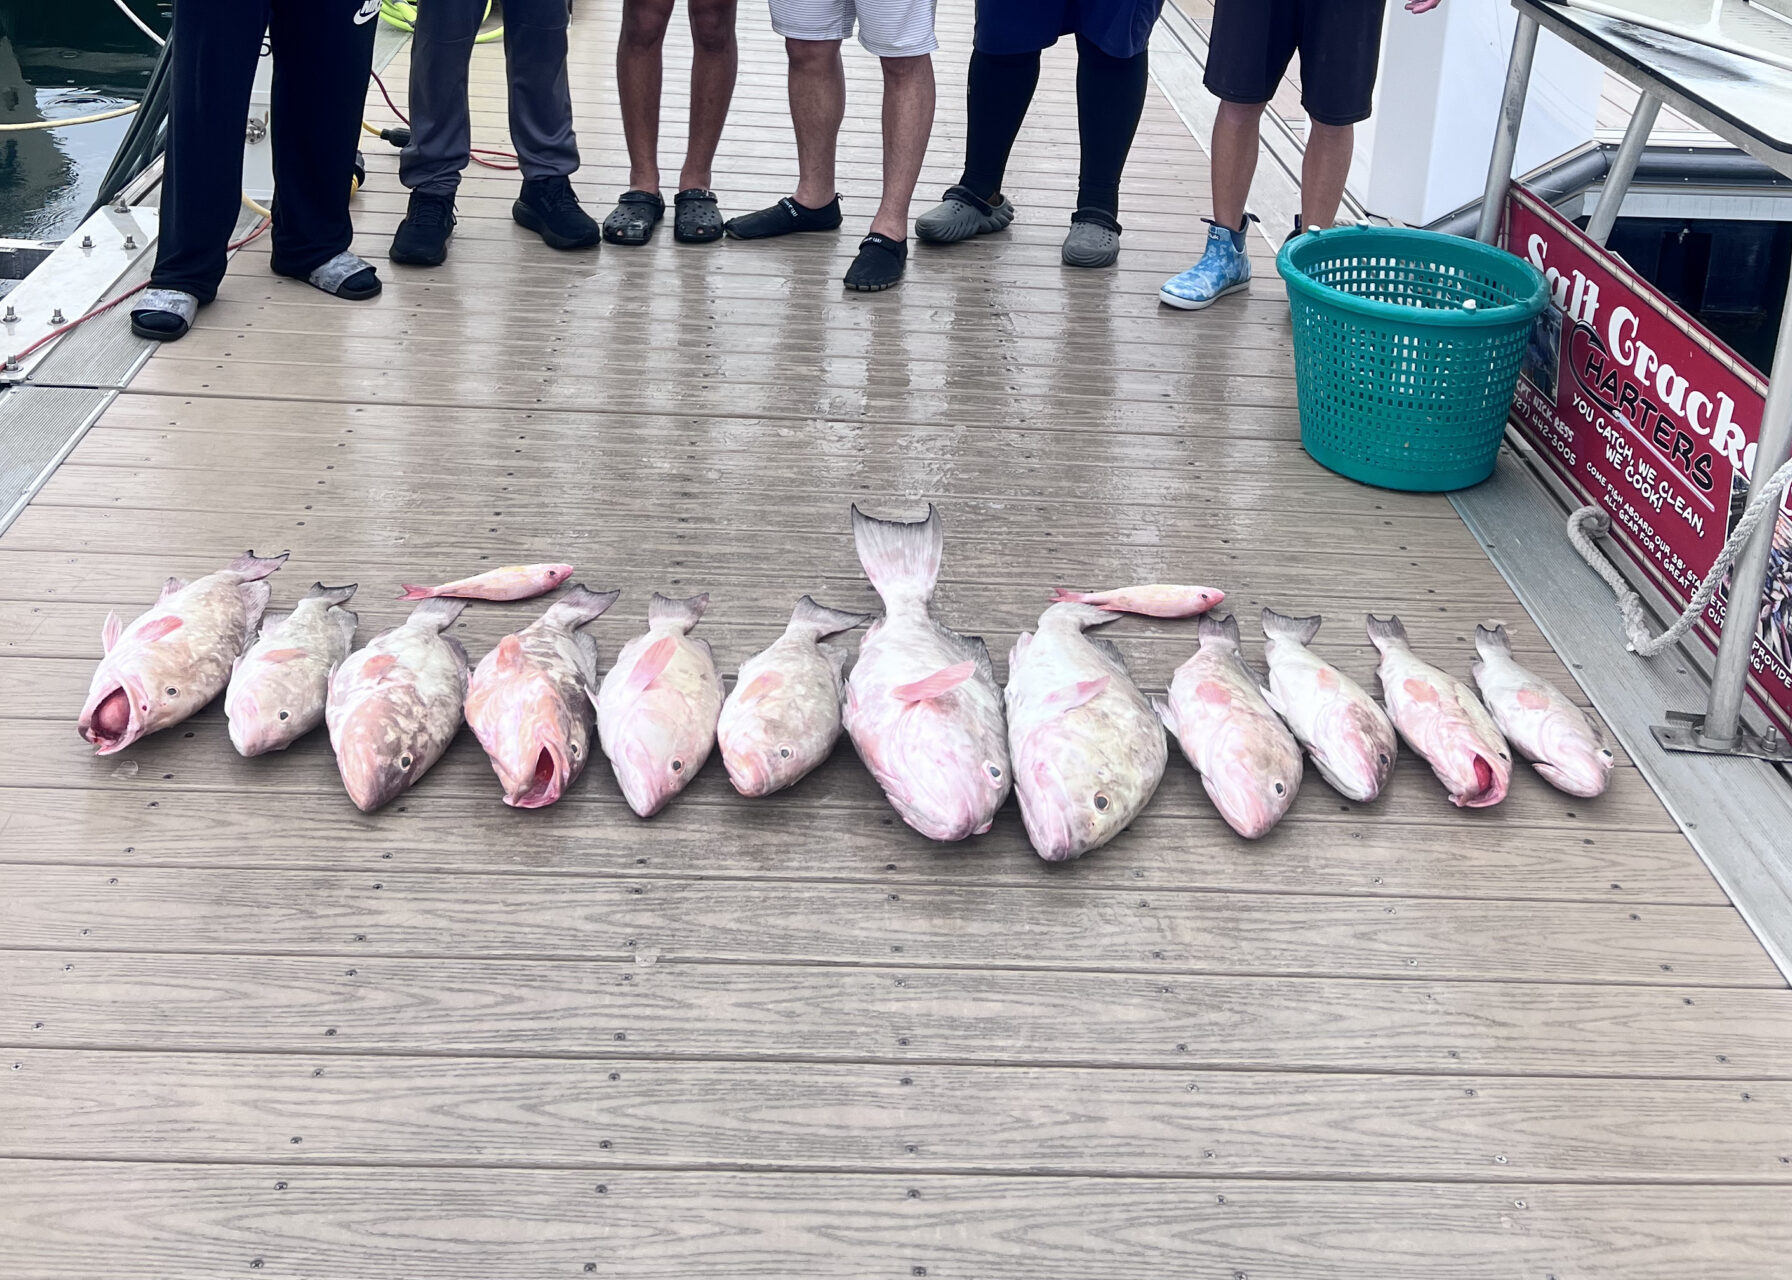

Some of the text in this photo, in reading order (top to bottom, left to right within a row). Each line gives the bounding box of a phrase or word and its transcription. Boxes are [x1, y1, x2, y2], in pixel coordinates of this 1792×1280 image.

[1524, 233, 1758, 481] Salt Crack
[1512, 393, 1577, 466] 727) 442-3005
[1572, 392, 1705, 538] YOU CATCH, WE CLEAN,
[1586, 462, 1607, 487] COME
[1607, 483, 1624, 504] FISH
[1624, 503, 1655, 536] ABOARD
[1654, 535, 1671, 556] OUR
[1605, 444, 1663, 513] WE COOK!
[1603, 495, 1619, 512] ALL
[1618, 510, 1639, 535] GEAR
[1639, 532, 1655, 552] FOR
[1655, 550, 1662, 561] A
[1663, 558, 1690, 589] GREAT
